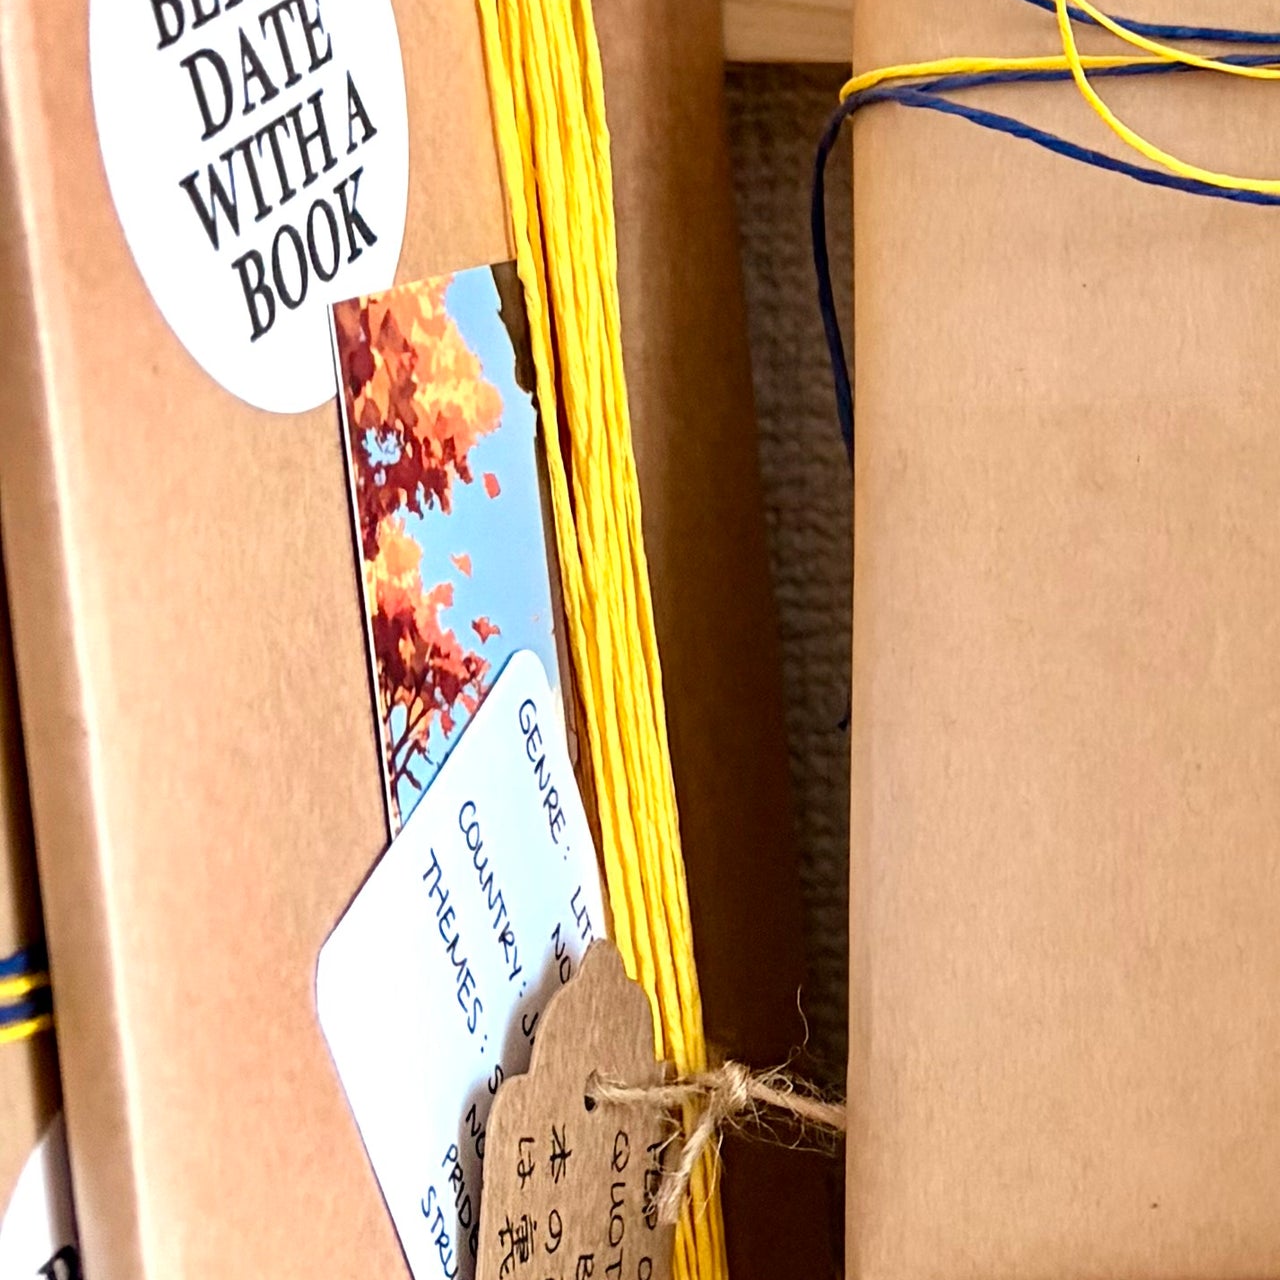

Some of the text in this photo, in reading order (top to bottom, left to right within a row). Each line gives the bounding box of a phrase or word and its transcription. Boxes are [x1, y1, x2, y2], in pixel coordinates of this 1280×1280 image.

[179, 70, 377, 251] WITH A
[231, 166, 378, 343] BOOK
[459, 800, 527, 998] COUNTRY:
[517, 698, 595, 942] GENRE: LIT
[423, 848, 488, 1054] THEMES:
